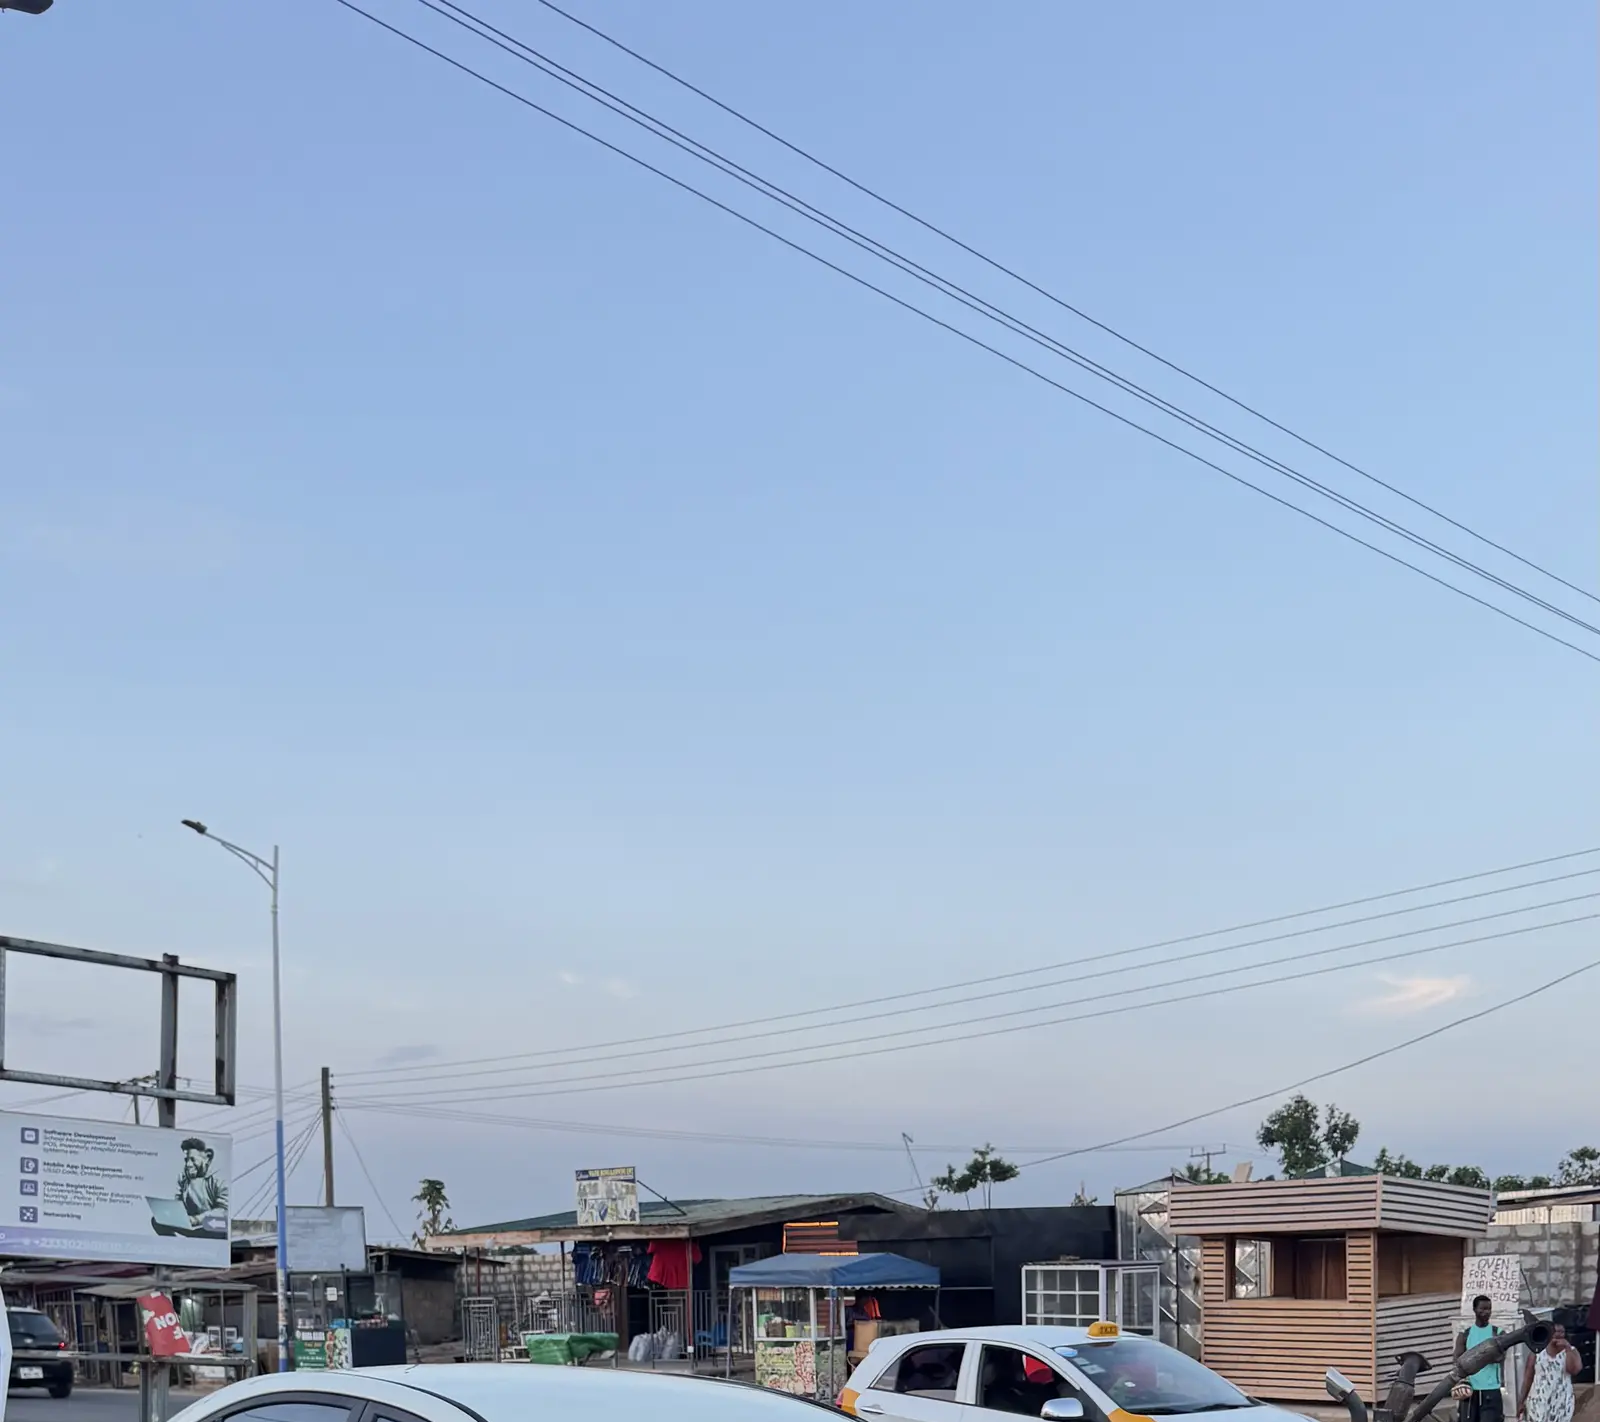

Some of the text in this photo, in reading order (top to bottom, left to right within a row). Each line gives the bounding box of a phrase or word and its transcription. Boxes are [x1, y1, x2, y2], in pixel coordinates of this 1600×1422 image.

[43, 1129, 116, 1141] Software Development
[66, 1163, 80, 1171] App
[81, 1164, 123, 1174] Development
[66, 1182, 105, 1191] Registration
[43, 1211, 82, 1220] Networking
[1477, 1257, 1510, 1270] OVEN
[1470, 1270, 1517, 1281] FOR SALE
